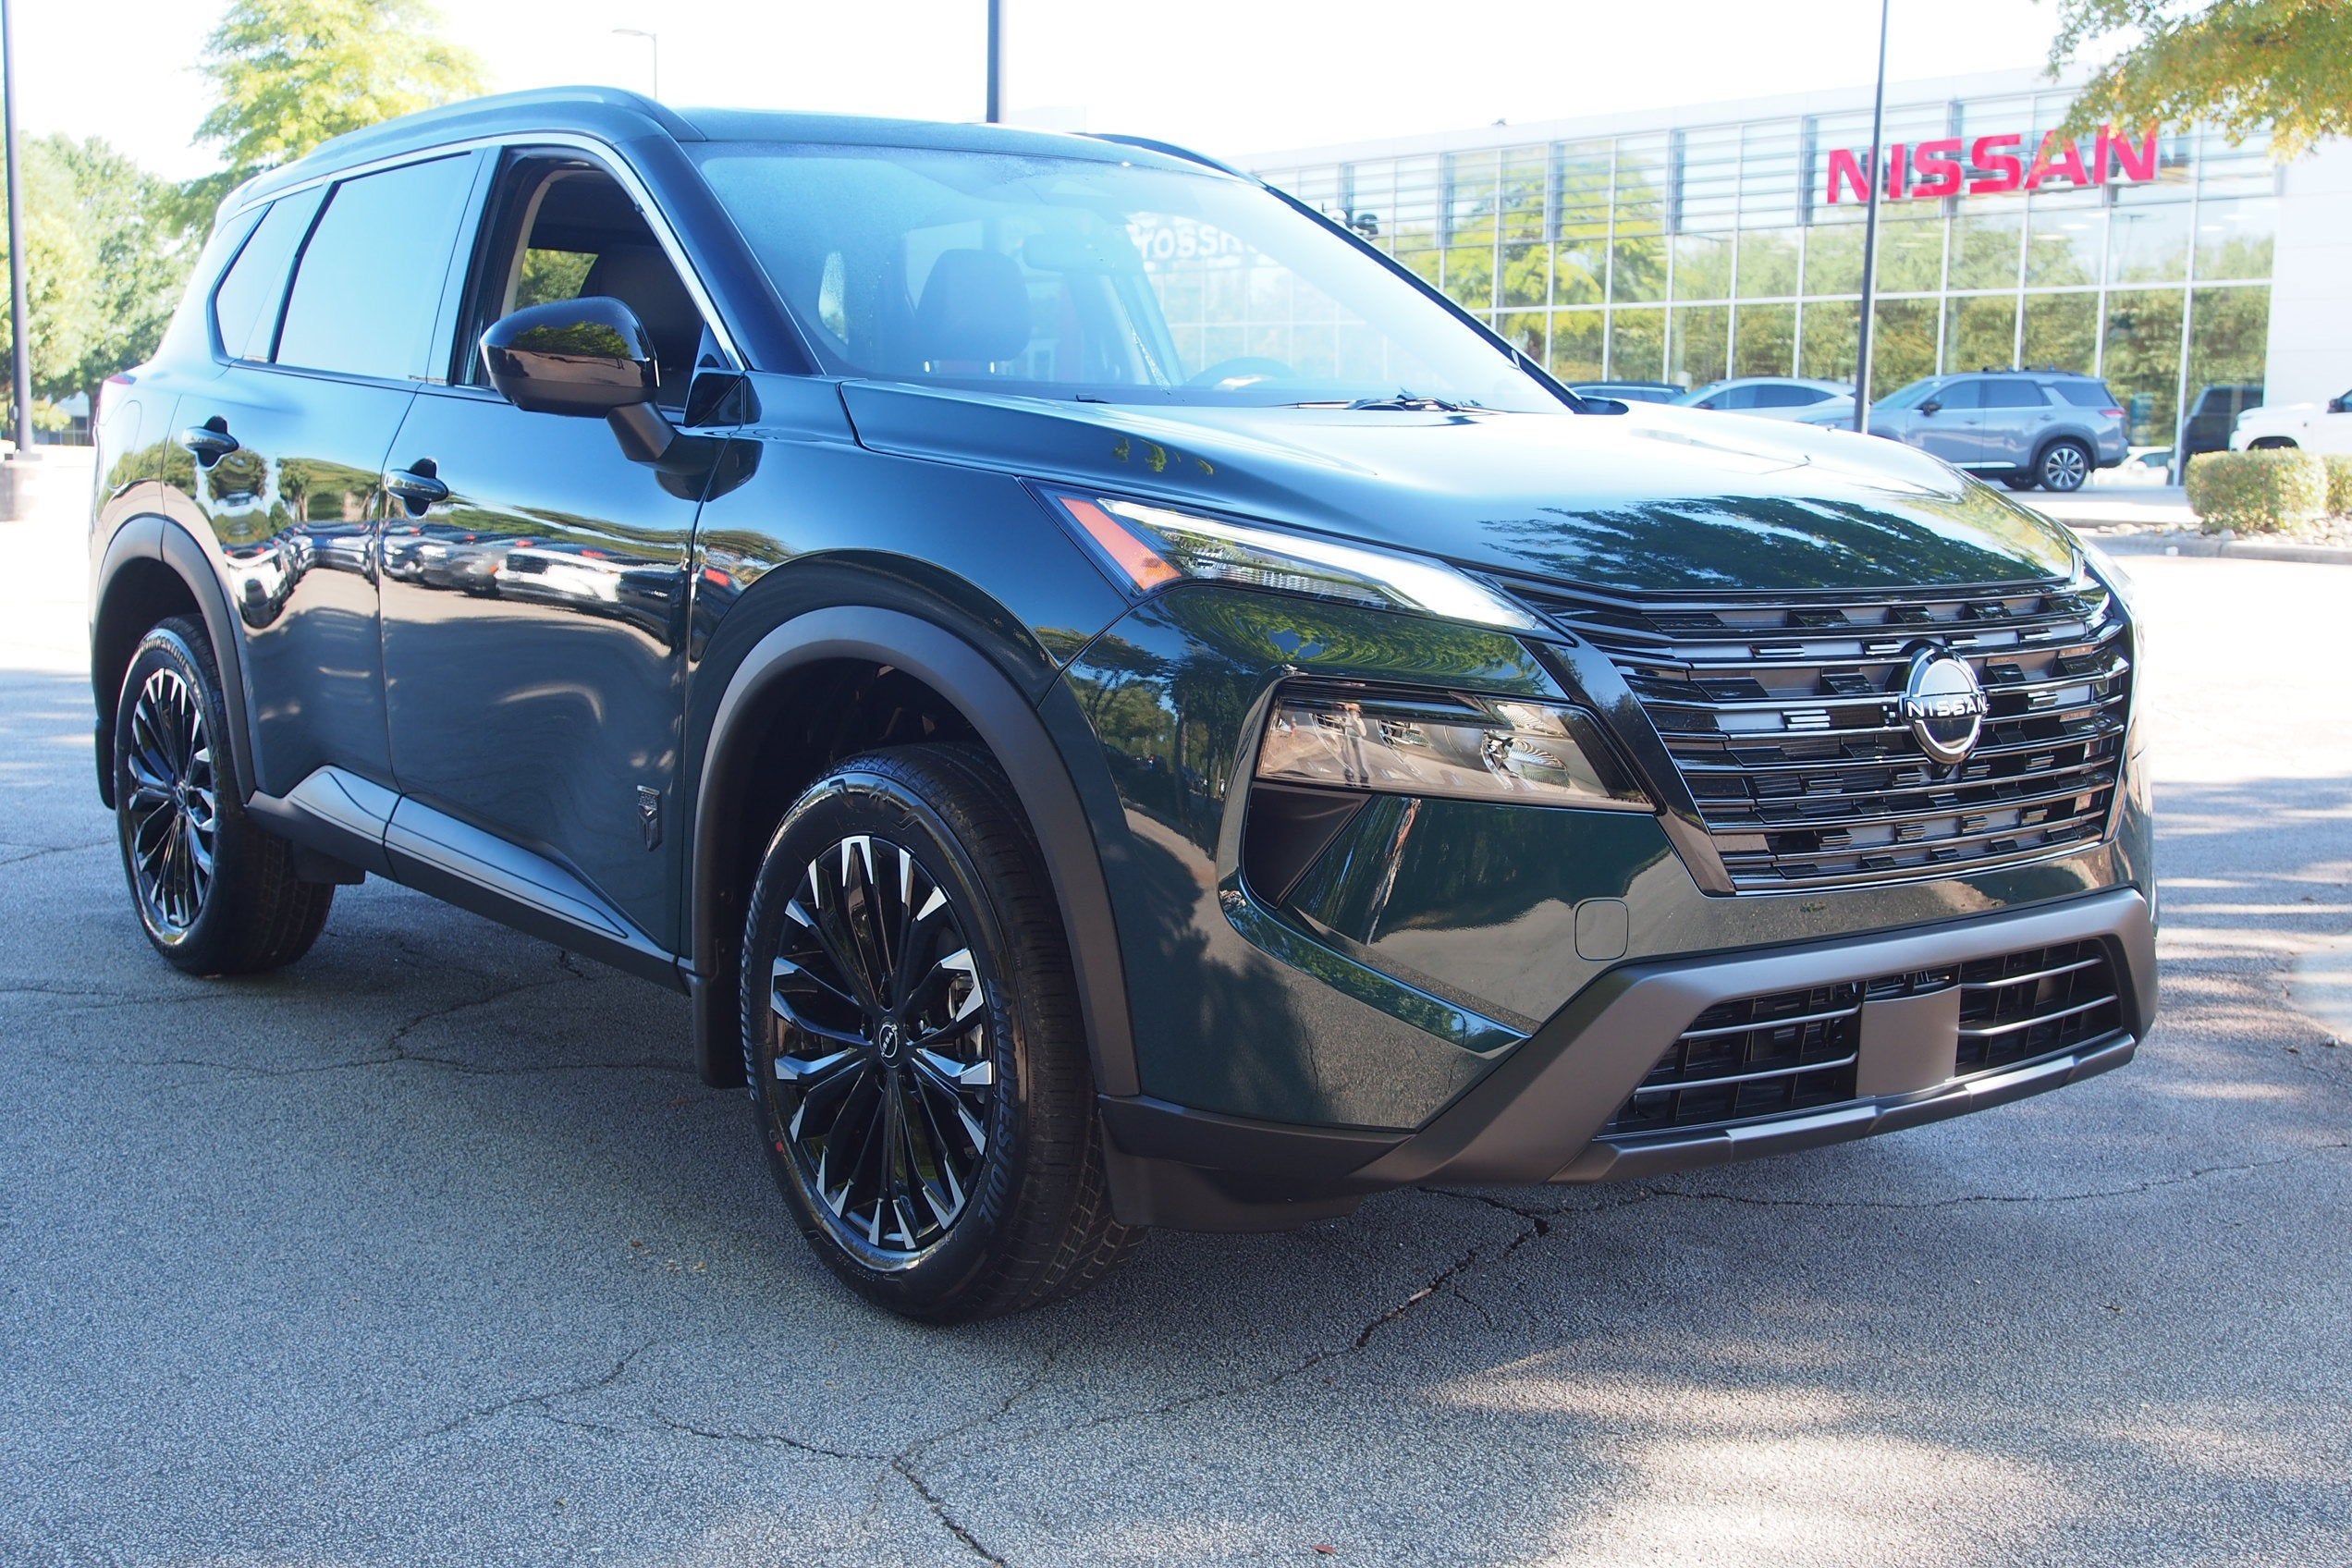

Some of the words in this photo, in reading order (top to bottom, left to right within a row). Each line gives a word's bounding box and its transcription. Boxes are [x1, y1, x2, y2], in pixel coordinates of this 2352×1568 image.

[1827, 119, 2160, 204] NISSAN
[1906, 696, 1987, 717] NISSAN
[979, 978, 1020, 1226] BRIDGESTONE
